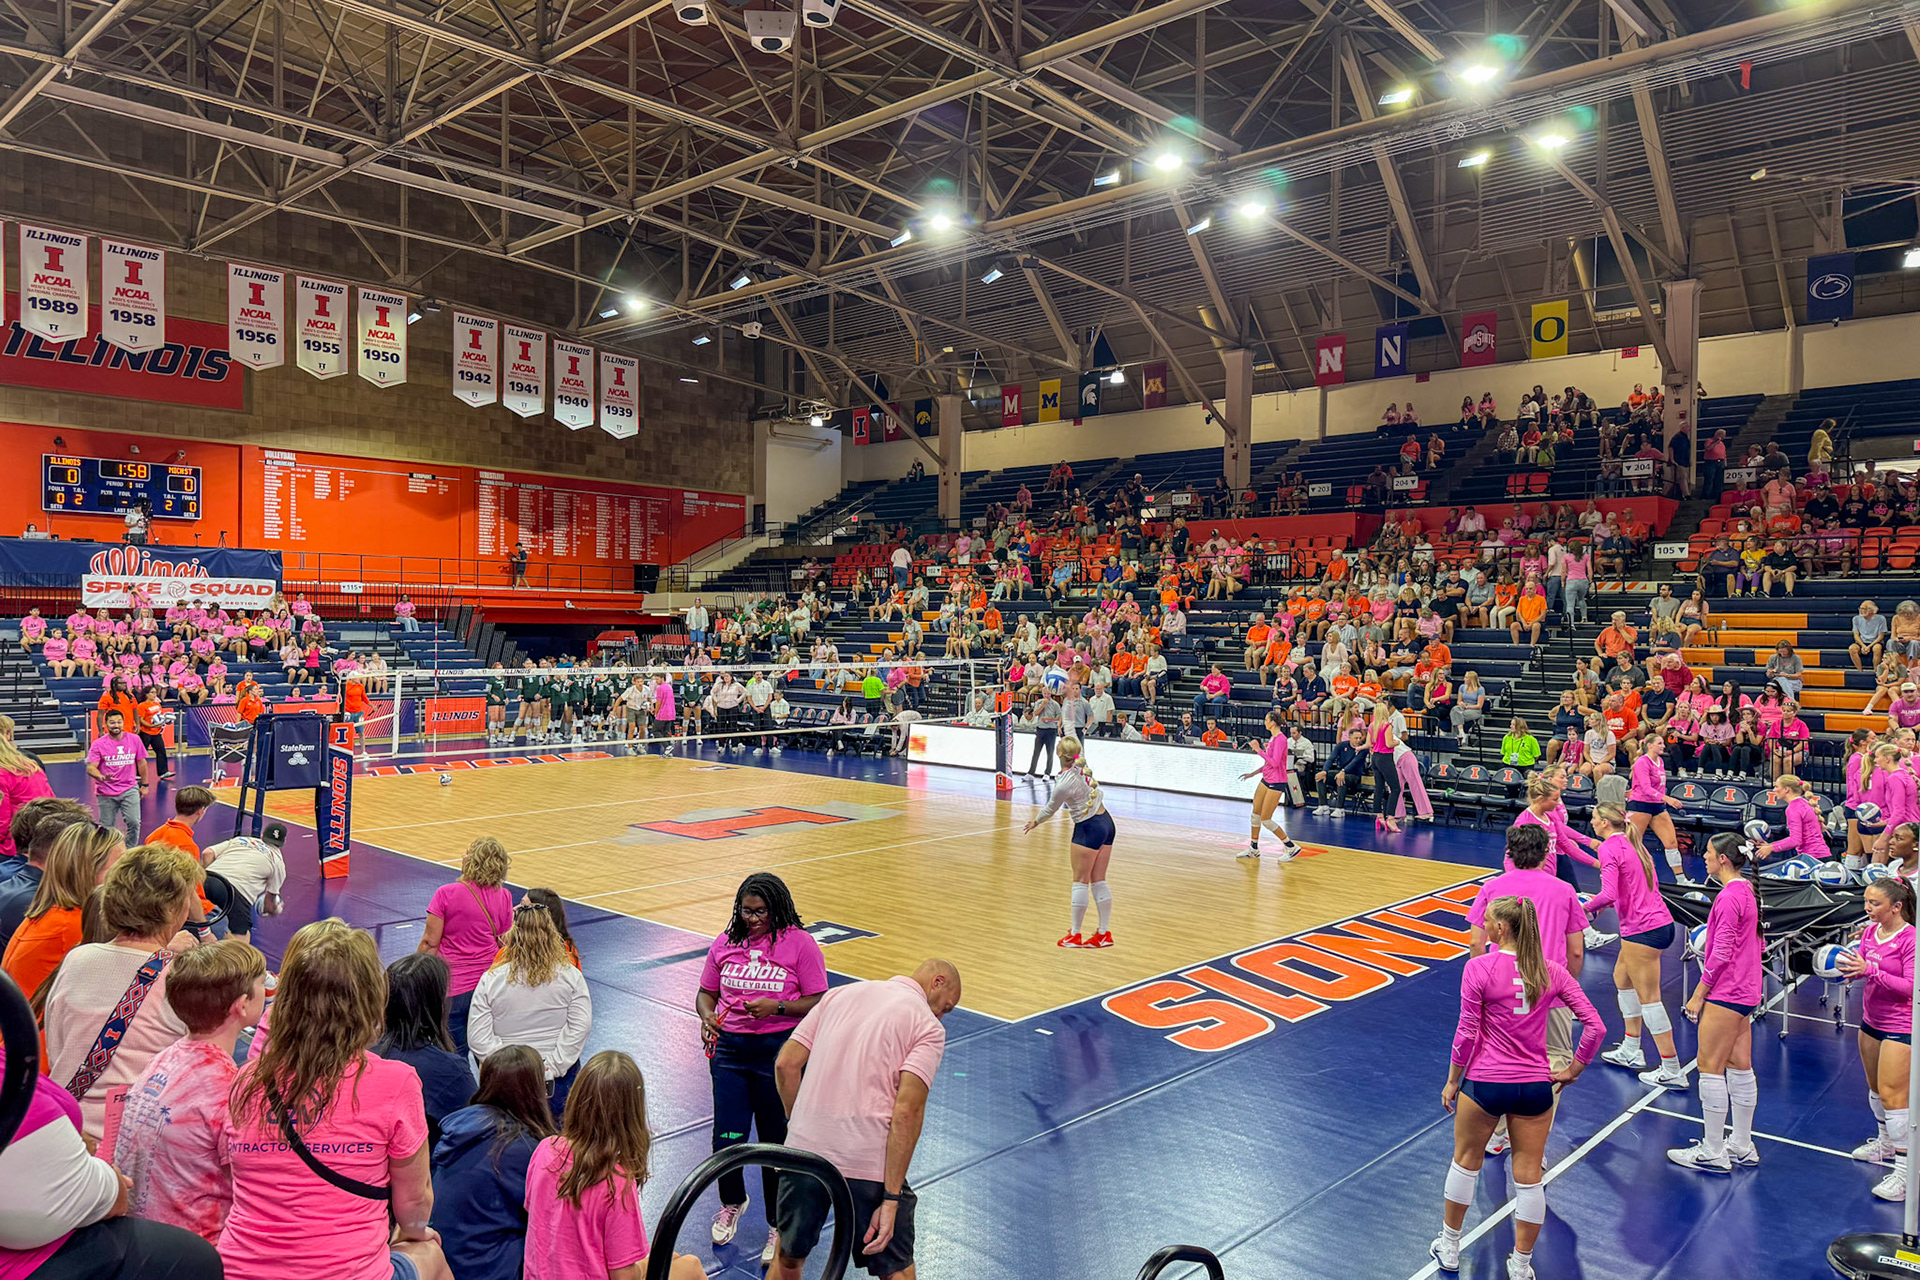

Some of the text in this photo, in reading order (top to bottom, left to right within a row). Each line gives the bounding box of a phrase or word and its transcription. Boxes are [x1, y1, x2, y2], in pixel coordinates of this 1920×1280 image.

[26, 229, 82, 246] ILLINOIS
[44, 246, 64, 272] I
[108, 245, 159, 260] ILLINOIS
[125, 260, 142, 285] I
[234, 268, 279, 282] ILLINOIS
[34, 274, 71, 288] NCAA
[301, 281, 344, 294] ILLINOIS
[115, 287, 149, 300] NCAA
[249, 283, 265, 306] I
[362, 292, 403, 305] ILLINOIS
[28, 297, 78, 315] 1989
[315, 294, 330, 317] I
[110, 310, 155, 326] 1958
[240, 308, 271, 320] NCAA
[376, 306, 390, 327] I
[307, 319, 336, 331] NCAA
[458, 316, 494, 329] ILLINOIS
[1534, 317, 1565, 342] O
[236, 329, 276, 344] 1956
[368, 329, 395, 341] NCAA
[469, 329, 482, 349] I
[508, 329, 542, 341] ILLINOIS
[303, 340, 340, 354] 1955
[519, 341, 531, 361] I
[557, 344, 590, 356] ILLINOIS
[1381, 335, 1401, 367] N
[364, 349, 400, 363] 1950
[462, 351, 487, 362] NCAA
[604, 355, 635, 367] ILLINOIS
[1319, 346, 1343, 374] N
[512, 363, 536, 374] NCAA
[568, 356, 580, 375] I
[458, 370, 491, 384] 1942
[562, 377, 584, 388] NCAA
[614, 368, 625, 386] I
[509, 381, 539, 395] 1941
[608, 388, 629, 398] NCAA
[558, 395, 588, 408] 1940
[1004, 394, 1018, 415] M
[1042, 393, 1058, 408] M
[605, 406, 632, 417] 1939
[856, 416, 866, 437] I
[50, 457, 81, 466] ILLINOIS
[1634, 463, 1651, 471] 204
[67, 469, 77, 483] 0
[118, 464, 147, 479] 1:58
[184, 478, 194, 492] 0
[56, 493, 83, 505] 0 2
[165, 500, 197, 512] 2 0
[85, 581, 274, 597] SPIKE SQUAD
[432, 711, 479, 721] ILLINOIS
[336, 727, 348, 744] I
[1438, 765, 1449, 776] I
[1470, 767, 1480, 779] I
[1503, 770, 1513, 782] I
[1572, 776, 1582, 788] I
[1683, 784, 1695, 798] I
[1724, 788, 1737, 802] I
[329, 757, 348, 850] ILLINOIS
[720, 962, 788, 980] ILLINOIS
[1513, 977, 1530, 1015] 3
[228, 1142, 374, 1154] ONTRACTO SERVICES
